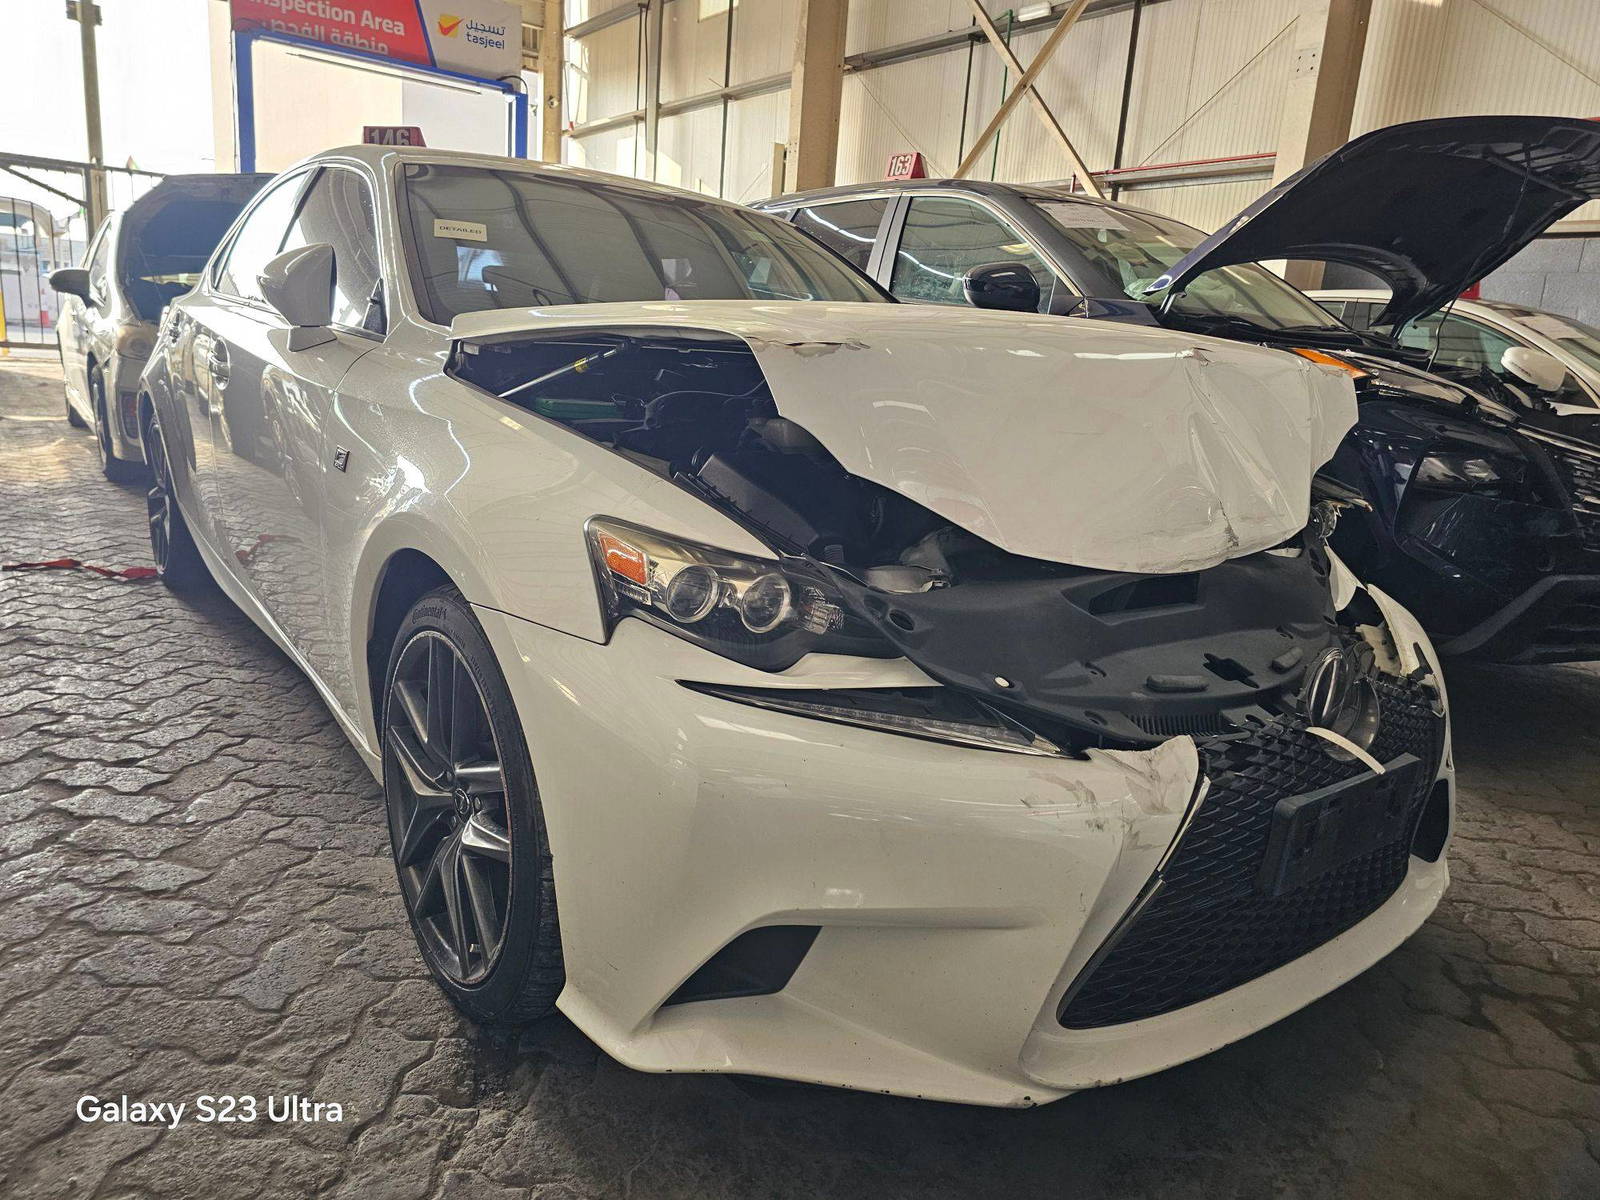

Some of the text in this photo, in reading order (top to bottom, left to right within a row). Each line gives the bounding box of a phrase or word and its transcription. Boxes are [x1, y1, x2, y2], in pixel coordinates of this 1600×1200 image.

[251, 0, 406, 37] spection Area
[466, 20, 506, 36] تسجيل
[466, 32, 505, 50] tasjeel
[370, 127, 410, 145] 146
[889, 155, 913, 177] 163
